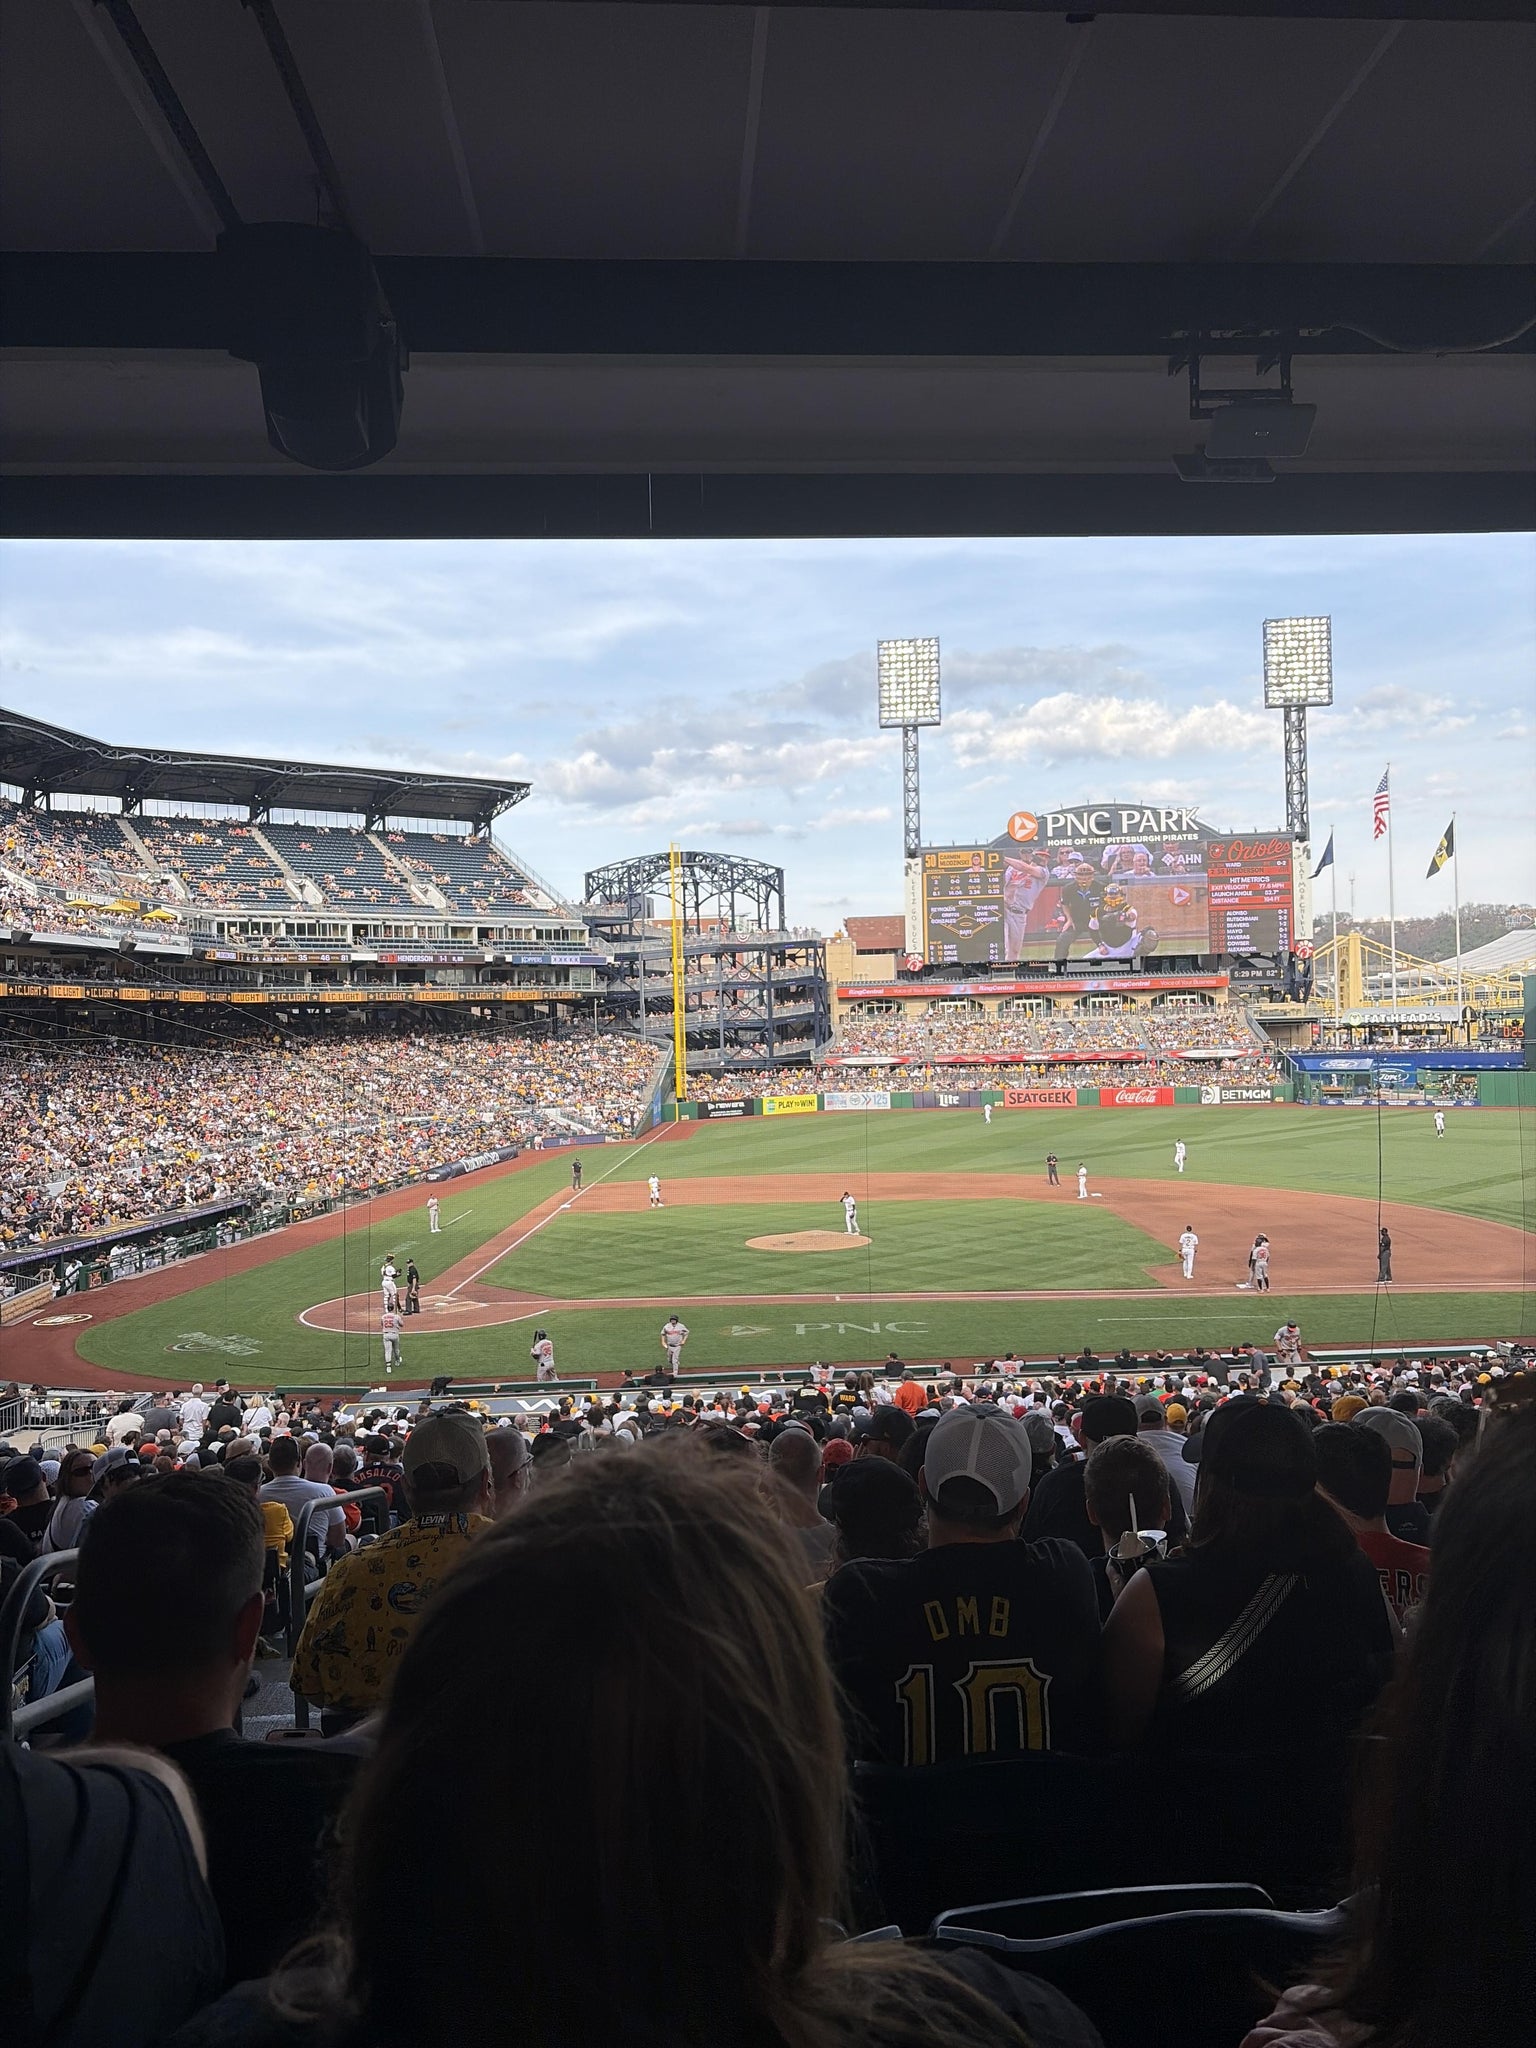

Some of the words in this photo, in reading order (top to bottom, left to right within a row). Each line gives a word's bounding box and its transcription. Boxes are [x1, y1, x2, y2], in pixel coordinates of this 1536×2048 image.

[1044, 811, 1111, 837] PNC
[1118, 807, 1200, 834] PARK
[1048, 839, 1073, 847] HOME
[1088, 837, 1105, 845] THE
[1107, 835, 1161, 844] PITTSBURGH
[1162, 833, 1199, 842] PIRATES
[1228, 838, 1291, 860] Orioles
[1177, 854, 1202, 865] AHN
[1234, 969, 1249, 977] 5:29
[1250, 969, 1263, 977] PM
[23, 986, 42, 996] LIGHT
[63, 987, 80, 997] LIGHT
[99, 988, 114, 998] LIGHT
[132, 990, 145, 999] LIGHT
[161, 990, 174, 1000] LIGHT
[386, 992, 406, 1000] LIGHT
[558, 991, 576, 999] LIGHT
[289, 993, 310, 1002] LIGHT
[338, 993, 359, 1001] LIGHT
[1364, 1014, 1386, 1023] FAT
[873, 1094, 888, 1105] 125
[1008, 1091, 1073, 1105] SEATGEEK
[1115, 1089, 1158, 1104] Coca-Cola
[1221, 1089, 1271, 1100] BETMGM
[778, 1101, 794, 1110] PLAY
[800, 1099, 815, 1108] WIN!
[938, 1094, 960, 1107] Lite
[792, 1321, 929, 1335] PNC
[840, 1394, 856, 1402] WARD
[352, 1467, 401, 1484] BASALLO
[421, 1515, 446, 1525] LEVIN
[923, 1595, 1011, 1642] DMB
[895, 1657, 1054, 1768] 10
